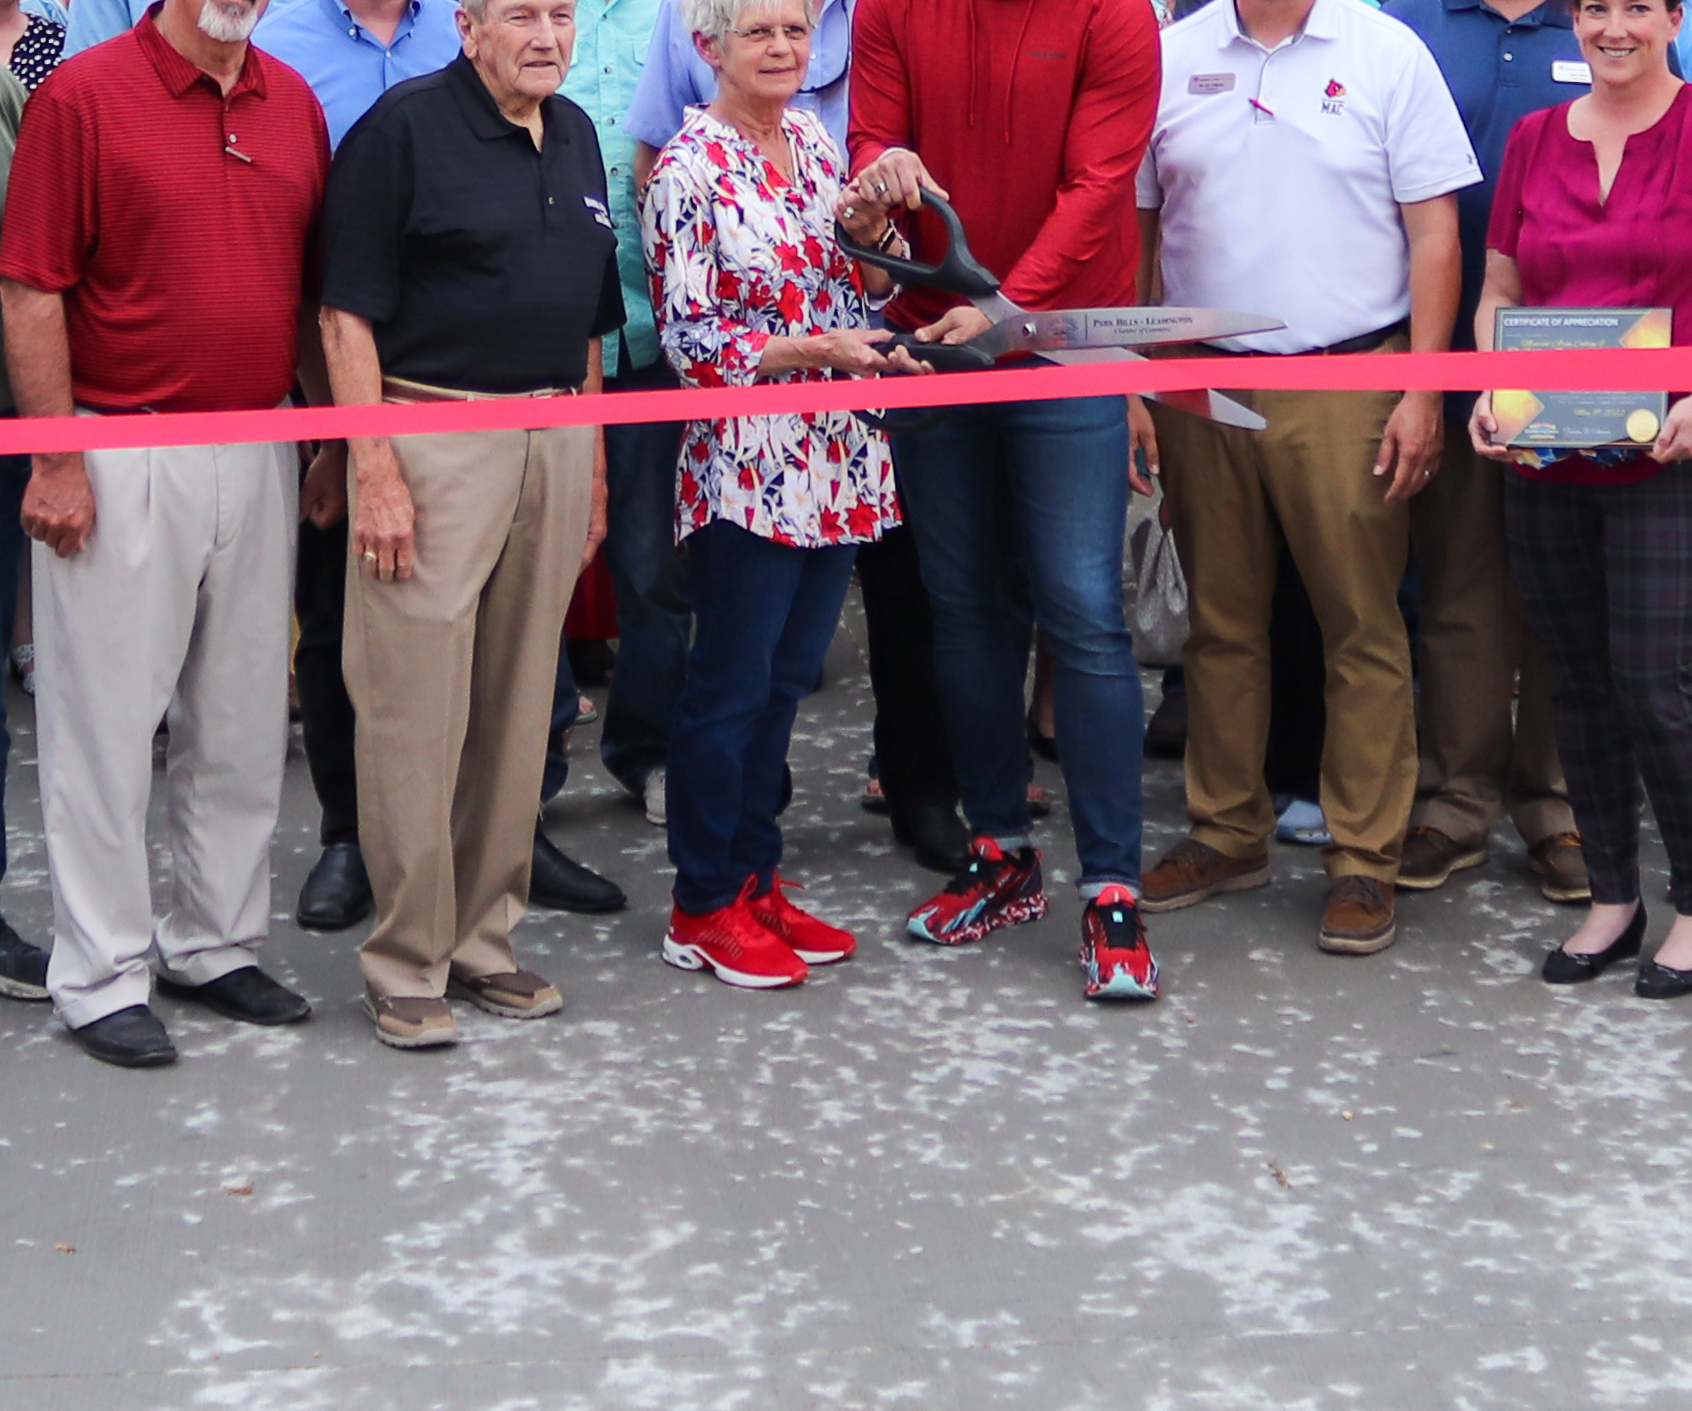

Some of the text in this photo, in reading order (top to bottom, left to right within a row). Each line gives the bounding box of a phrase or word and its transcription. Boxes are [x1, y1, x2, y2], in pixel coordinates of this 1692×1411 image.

[1320, 101, 1344, 116] MAC
[1504, 318, 1619, 327] CERTIFICATE OF APPRECIATION
